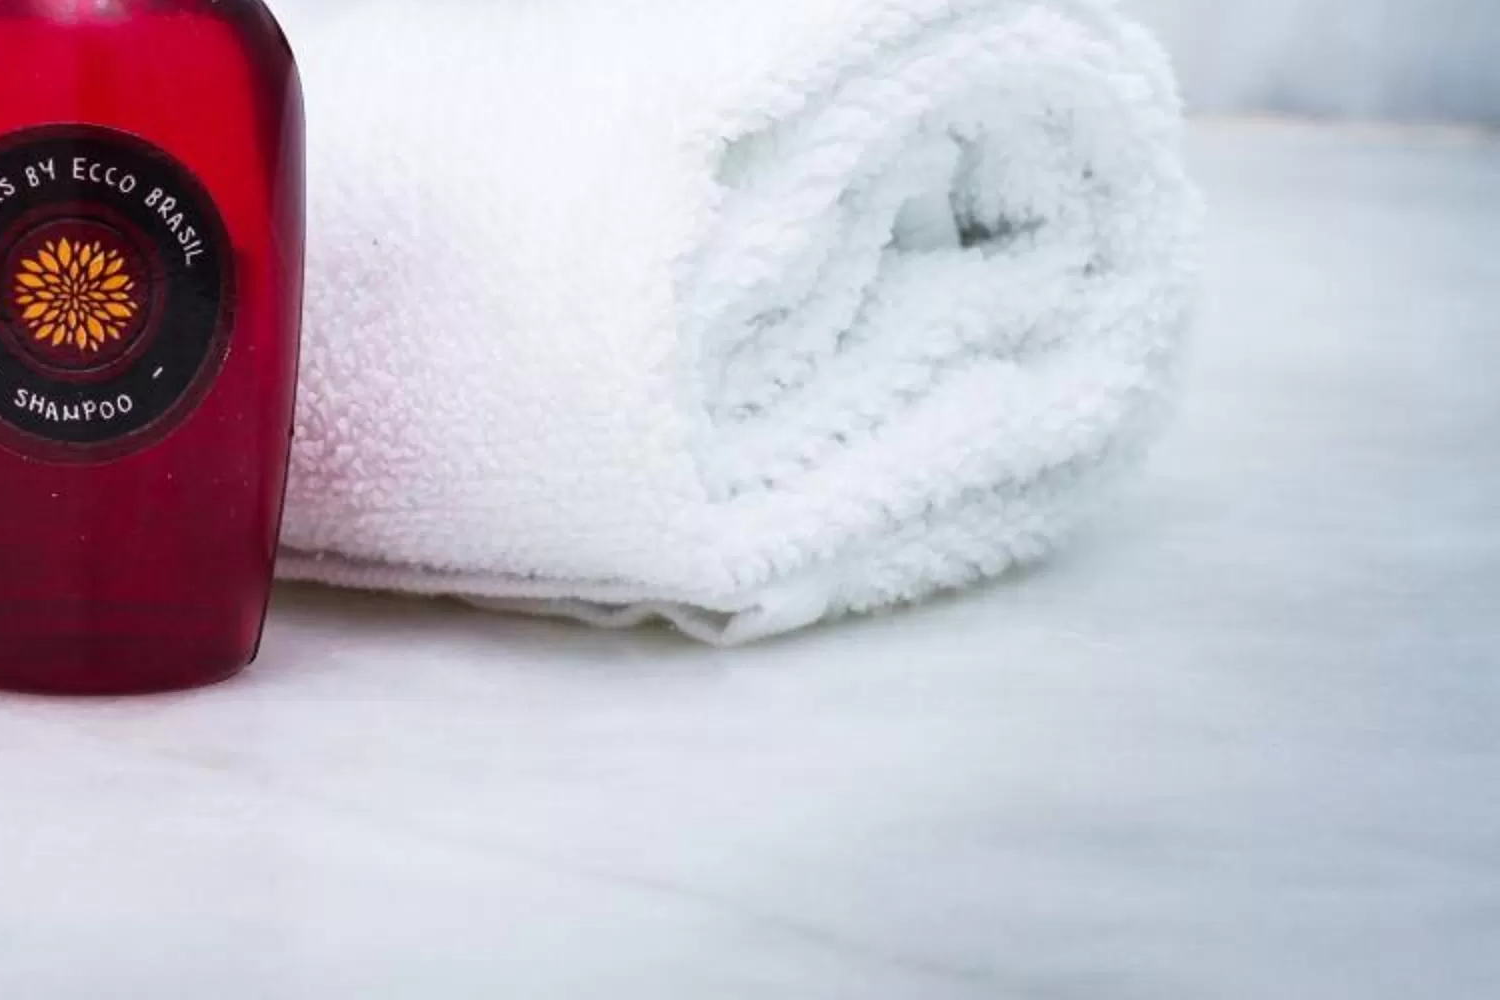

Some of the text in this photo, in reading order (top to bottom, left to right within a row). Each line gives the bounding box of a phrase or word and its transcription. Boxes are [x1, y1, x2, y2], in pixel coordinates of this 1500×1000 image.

[25, 158, 56, 188] BY
[73, 157, 137, 194] ECCO
[145, 188, 204, 267] BRASIL
[14, 389, 134, 422] SHAMPOO
